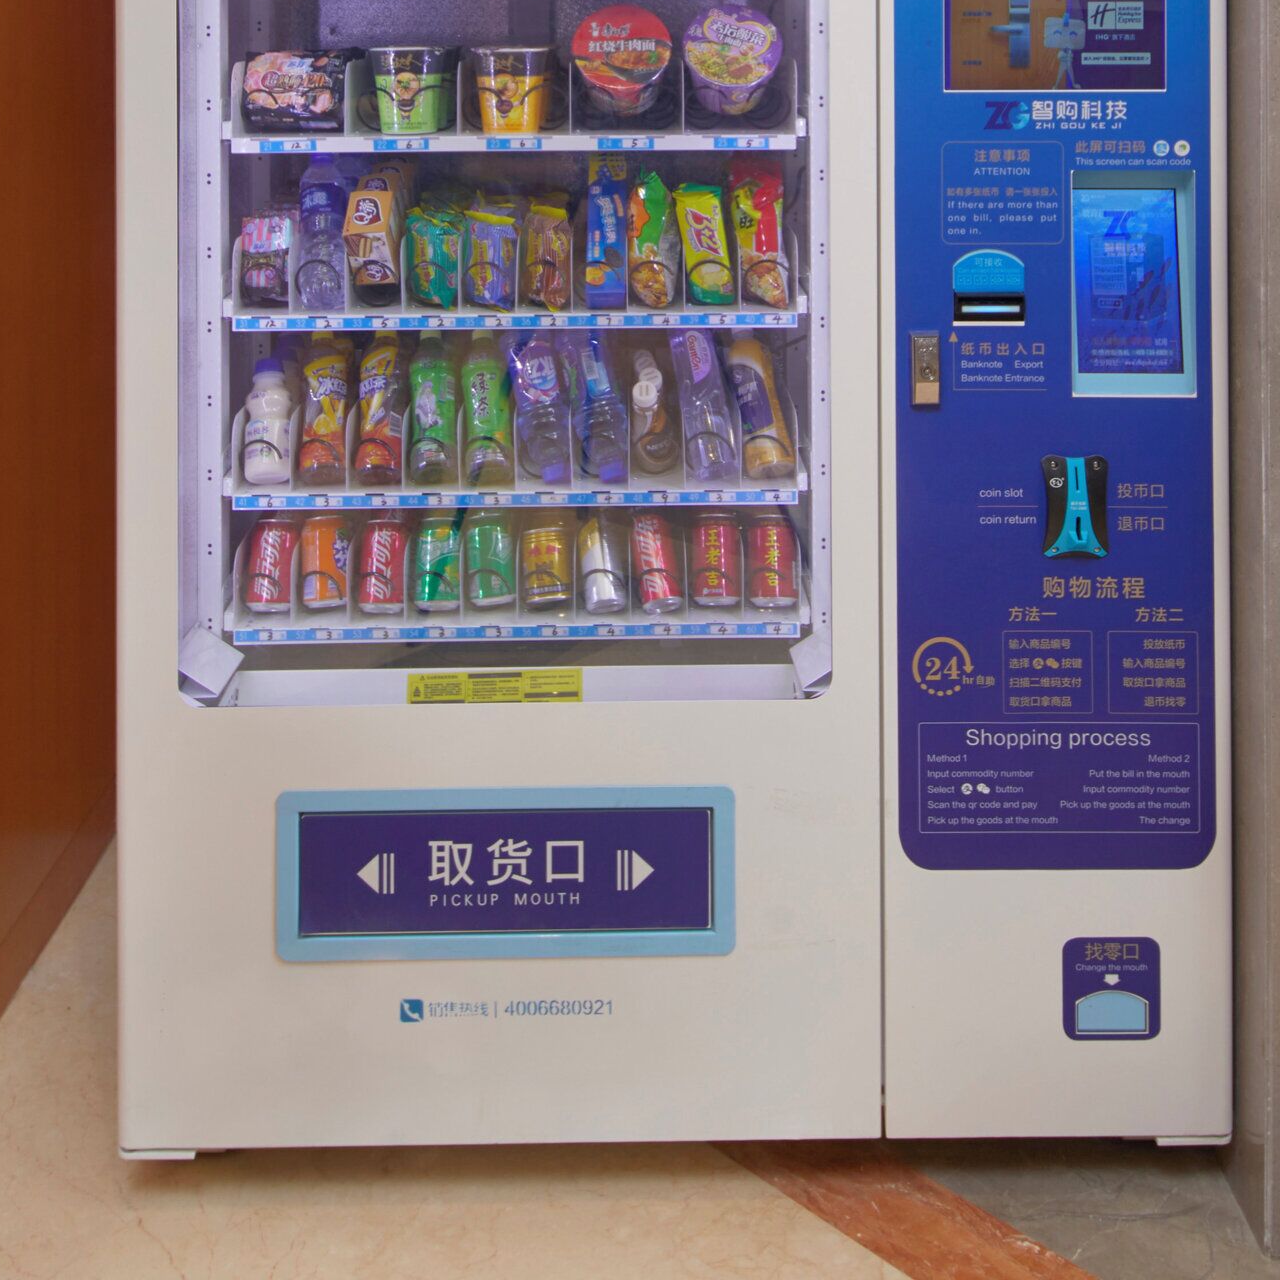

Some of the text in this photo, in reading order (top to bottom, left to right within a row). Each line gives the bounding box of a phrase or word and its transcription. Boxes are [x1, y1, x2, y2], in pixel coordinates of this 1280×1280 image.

[588, 38, 656, 52] 红烧牛肉面
[1032, 100, 1127, 120] 智购科技
[1036, 121, 1121, 130] ZHI GOU KE JI
[1075, 140, 1146, 154] 此屏可扫码
[975, 148, 1031, 163] 注意事项
[1075, 157, 1191, 166] This screen can scan code
[974, 166, 1030, 176] ATTENTION
[948, 200, 954, 209] If
[958, 201, 983, 209] there
[1008, 201, 1032, 209] more
[1036, 200, 1057, 209] than
[948, 213, 1056, 224] one bill, please put
[948, 227, 981, 235] one in.
[961, 342, 1044, 356] 纸币出入口
[961, 359, 1043, 370] Banknote Export
[961, 373, 1044, 383] Banknote Entrance
[980, 487, 1023, 498] coin slot
[1118, 482, 1163, 499] 投币口
[980, 514, 1036, 525] coin return
[1118, 515, 1164, 532] 退币口
[705, 528, 721, 586] 王老吉
[765, 528, 782, 587] 王老吉
[1043, 575, 1145, 600] 购物流程
[1009, 605, 1057, 622] 方法一
[1136, 606, 1183, 623] 方法二
[1009, 639, 1071, 650] 输入商品编号
[1143, 638, 1185, 650] 投放纸币
[1009, 657, 1082, 669] 选择 按键
[1123, 657, 1185, 669] 输入商品编号
[925, 656, 995, 687] 24 hr 自助
[1009, 676, 1082, 688] 扫描二维码支付
[1123, 677, 1186, 689] 取货口拿商品
[1009, 696, 1072, 708] 取货口拿商品
[1144, 696, 1186, 708] 退币找零
[966, 728, 1150, 750] Shopping process
[927, 754, 967, 763] Method 1
[1148, 754, 1190, 763] Method 2
[928, 768, 1034, 779] Input commodity number
[1089, 768, 1190, 778] Put the bill in the mouth
[927, 785, 1024, 794] Select button
[1083, 785, 1190, 794] Input commodity number
[928, 800, 1037, 810] Scan the qr code and pay
[1060, 800, 1078, 808] Pick
[1081, 800, 1091, 809] up
[1109, 800, 1135, 810] goods
[1164, 800, 1190, 809] mouth
[928, 816, 946, 824] Pick
[947, 816, 959, 825] up
[961, 816, 974, 824] the
[977, 816, 1003, 825] goods
[1139, 816, 1190, 825] The change
[428, 838, 584, 887] 取货口
[430, 892, 579, 907] PICKUP MOUTH
[1084, 942, 1139, 961] 找零口
[1076, 964, 1106, 972] Change
[1108, 963, 1121, 971] the
[428, 999, 612, 1017] 销售热线 4006680921
